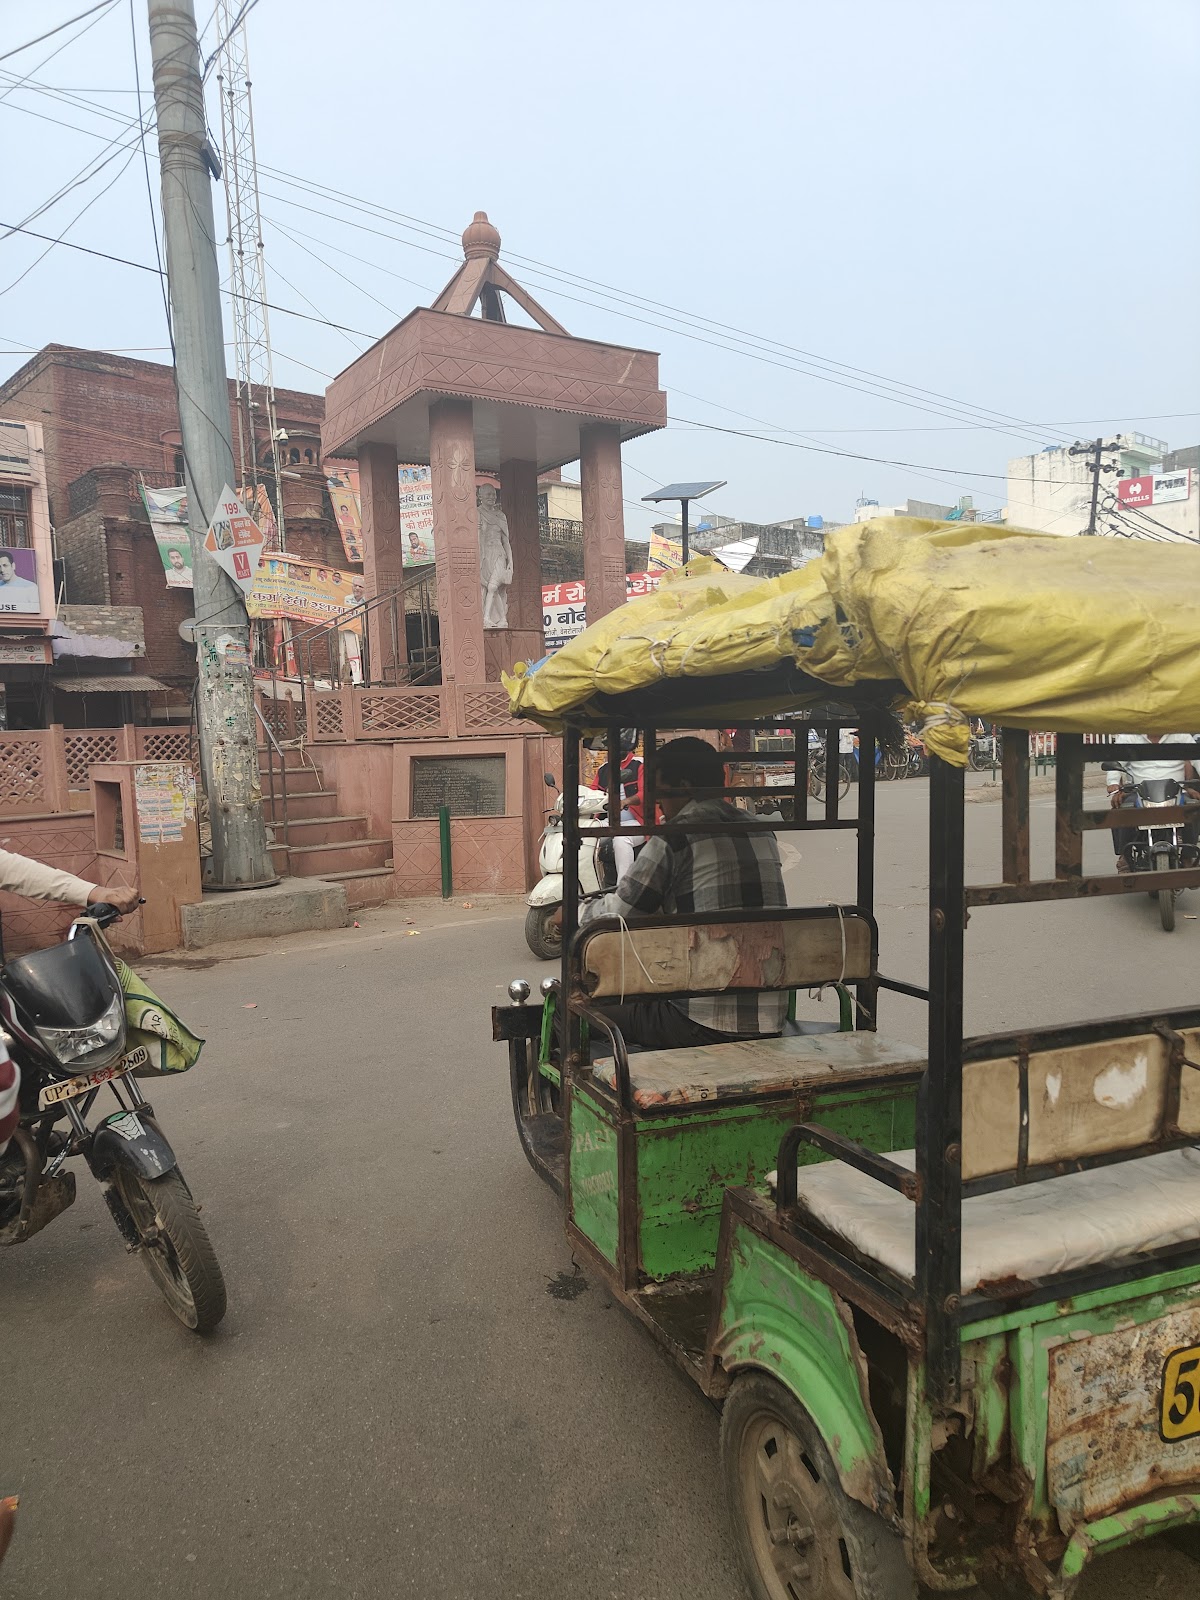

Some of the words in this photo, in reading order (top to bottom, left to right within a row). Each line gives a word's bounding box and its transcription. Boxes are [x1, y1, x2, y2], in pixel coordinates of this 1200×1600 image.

[224, 502, 239, 515] 199
[235, 554, 245, 570] V
[542, 585, 561, 603] र्म
[565, 583, 586, 601] रो
[120, 1048, 146, 1071] 2809
[1168, 1356, 1200, 1426] 5
